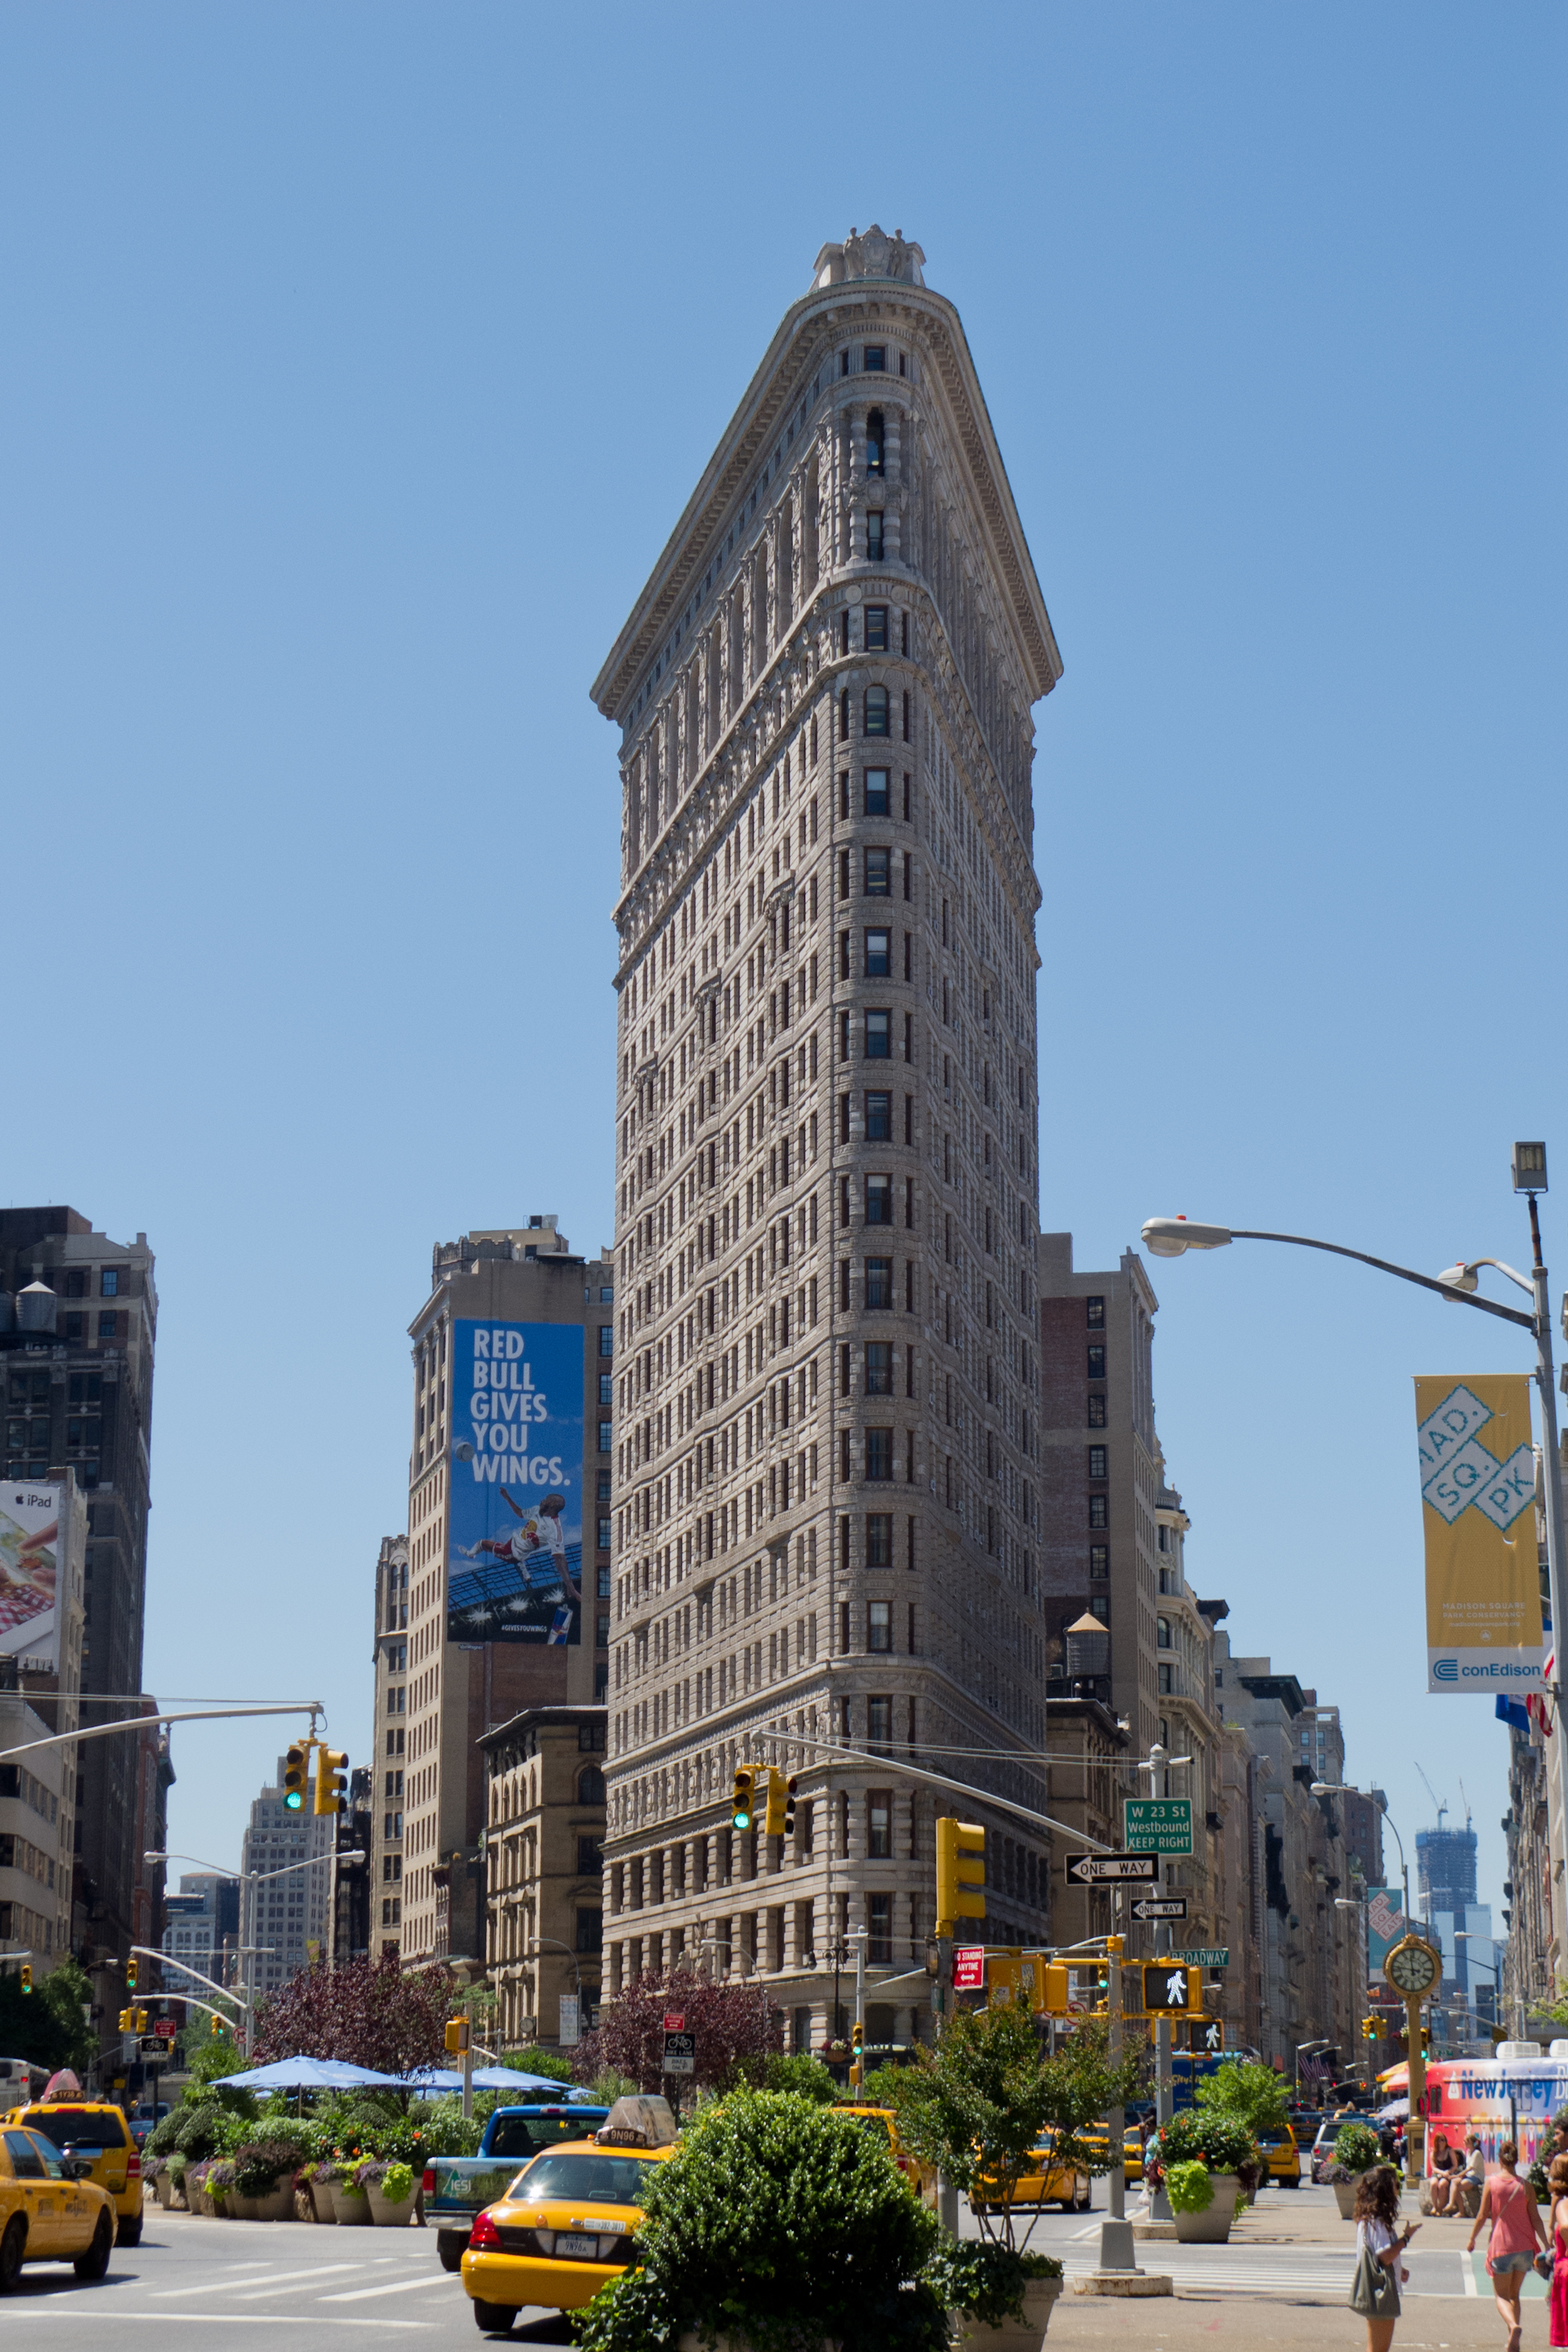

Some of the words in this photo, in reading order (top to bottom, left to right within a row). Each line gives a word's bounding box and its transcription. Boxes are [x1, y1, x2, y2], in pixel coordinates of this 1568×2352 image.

[474, 1329, 524, 1359] RED
[473, 1361, 535, 1391] BULL
[470, 1391, 547, 1423] GIVES
[471, 1422, 528, 1452] YOU
[471, 1454, 571, 1486] WINGS.
[1489, 1467, 1534, 1514] PK
[27, 1494, 52, 1508] iPad
[1461, 1663, 1541, 1676] conEdison
[1131, 1806, 1145, 1817] W
[1150, 1806, 1166, 1817] 23
[1171, 1806, 1185, 1817] St
[1127, 1820, 1189, 1833] Westbound
[1129, 1836, 1155, 1849] KEEP
[1158, 1836, 1190, 1848] RIGHT
[1080, 1863, 1106, 1875] ONE
[1119, 1862, 1147, 1874] WAY
[1138, 1905, 1154, 1914] ONE
[1162, 1904, 1180, 1913] WAY
[962, 1951, 982, 1961] STANDING
[957, 1962, 978, 1971] ANYTIME
[612, 2129, 635, 2141] 9N96
[452, 2180, 472, 2191] IESI
